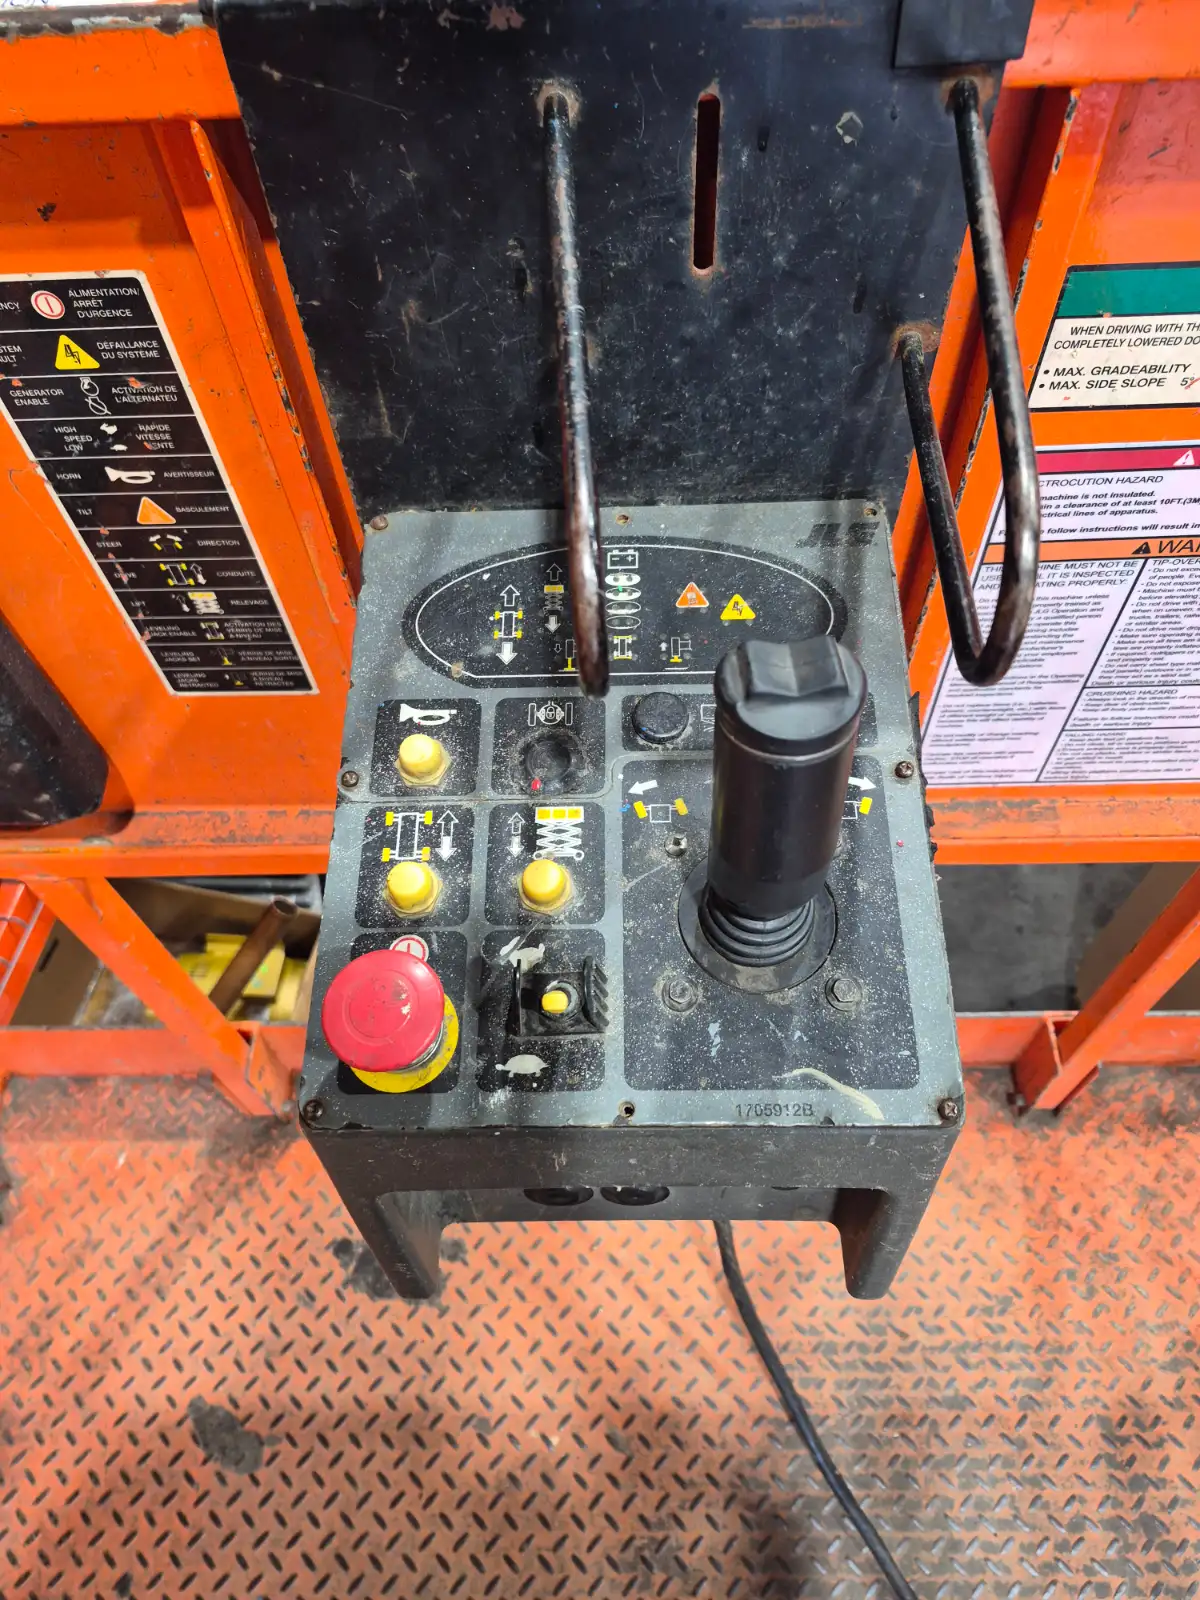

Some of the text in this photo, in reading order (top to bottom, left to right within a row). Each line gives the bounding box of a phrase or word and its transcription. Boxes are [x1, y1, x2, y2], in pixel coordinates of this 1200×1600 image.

[68, 287, 140, 298] ALIMENTATION/
[77, 308, 133, 319] D'URGENCE
[1070, 326, 1104, 335] WHEN
[1106, 324, 1152, 334] DRIVING
[1155, 323, 1184, 333] WITH
[1054, 338, 1126, 350] COMPLETELY
[1128, 336, 1182, 347] LOWERED
[1054, 364, 1192, 377] MAX. GRADEABILITY
[1049, 380, 1081, 390] MAX.
[1086, 379, 1118, 389] SIDE
[1121, 378, 1168, 388] SLOPE
[10, 388, 64, 397] GENERATOR
[111, 386, 163, 395] ACTIVATION
[14, 398, 50, 406] ENABLE
[139, 424, 171, 432] RAPIDE
[64, 435, 93, 443] SPEED
[136, 433, 172, 441] VITESSE
[64, 444, 84, 452] LOW
[147, 442, 175, 450] ENTE
[164, 470, 215, 478] AVERTISSEUR
[1116, 476, 1164, 484] HAZARD
[1110, 490, 1156, 498] insulated.
[1110, 508, 1158, 516] apparatus.
[1080, 525, 1139, 533] instructions
[1160, 522, 1189, 530] result
[1064, 562, 1096, 570] MUST
[1123, 560, 1140, 568] BE
[1072, 570, 1135, 578] INSPECTED
[735, 1103, 815, 1117] 1705912B
